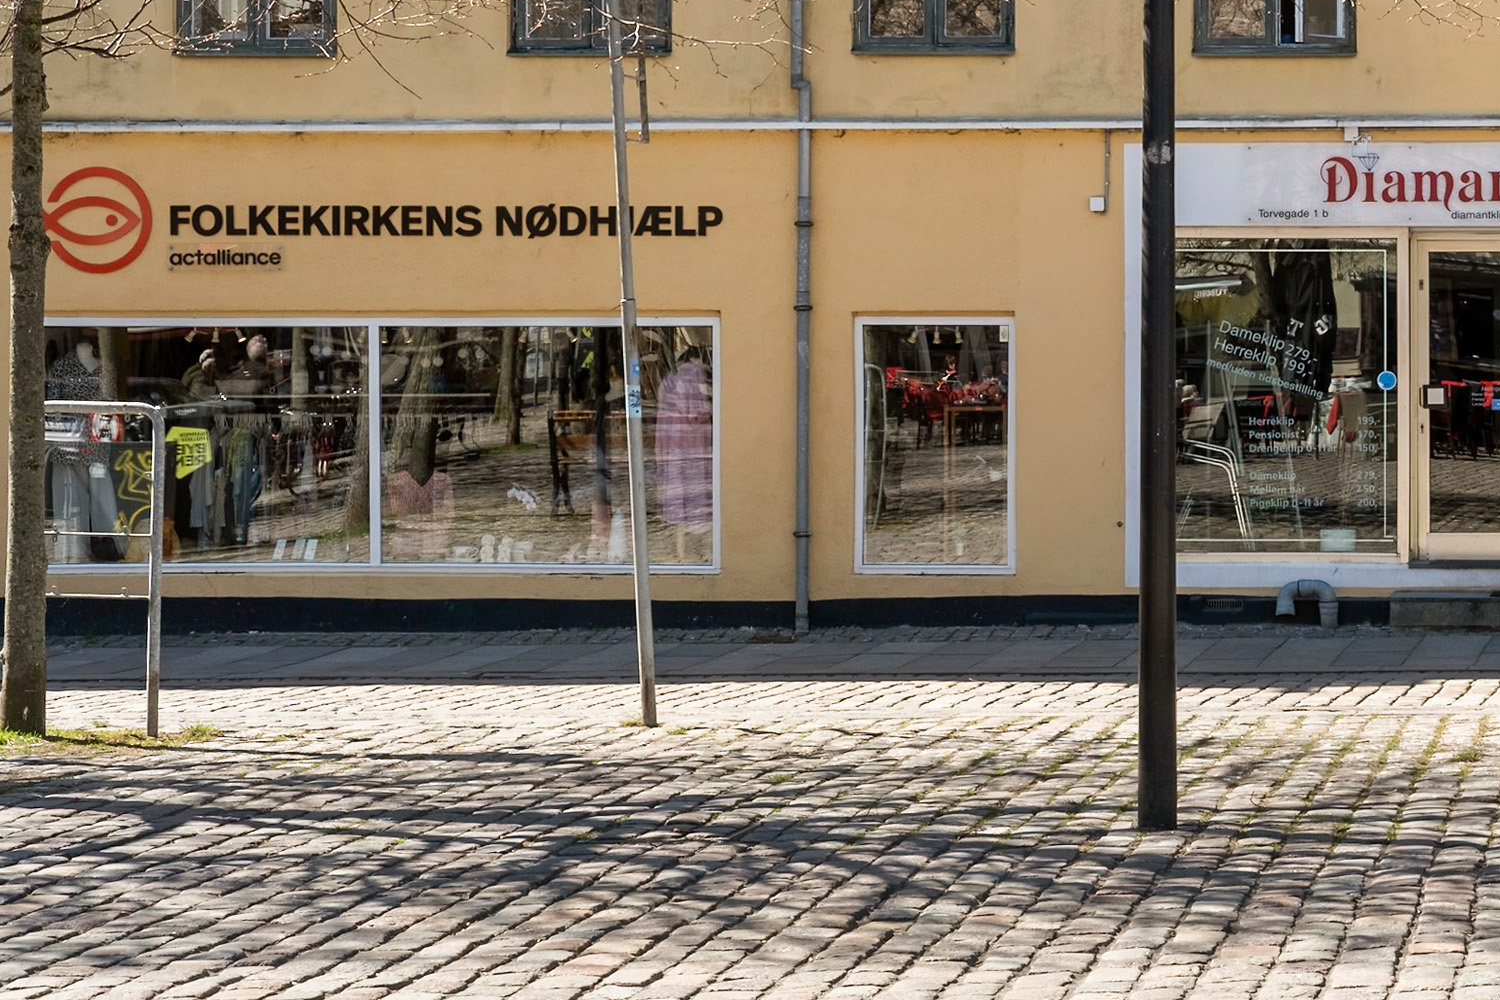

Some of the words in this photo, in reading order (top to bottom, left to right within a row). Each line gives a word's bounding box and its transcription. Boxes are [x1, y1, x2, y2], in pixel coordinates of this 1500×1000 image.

[1258, 208, 1310, 219] Torvegade
[1322, 209, 1329, 218] b
[170, 204, 482, 237] FOLKEKIRKENS
[169, 248, 281, 266] actalliance
[1219, 320, 1285, 351] Dameklip
[1285, 343, 1318, 363] 279,-
[1214, 337, 1277, 368] Herreklip
[1283, 357, 1313, 377] 199,-
[1206, 358, 1256, 382] med/uden
[1258, 373, 1324, 401] tidsbestilling
[1249, 416, 1295, 427] Herreklip
[1249, 430, 1300, 439] Pensionist
[1249, 444, 1304, 454] Drengeklip
[1250, 471, 1296, 482] Dameklip
[1250, 498, 1289, 509] Pigeklip
